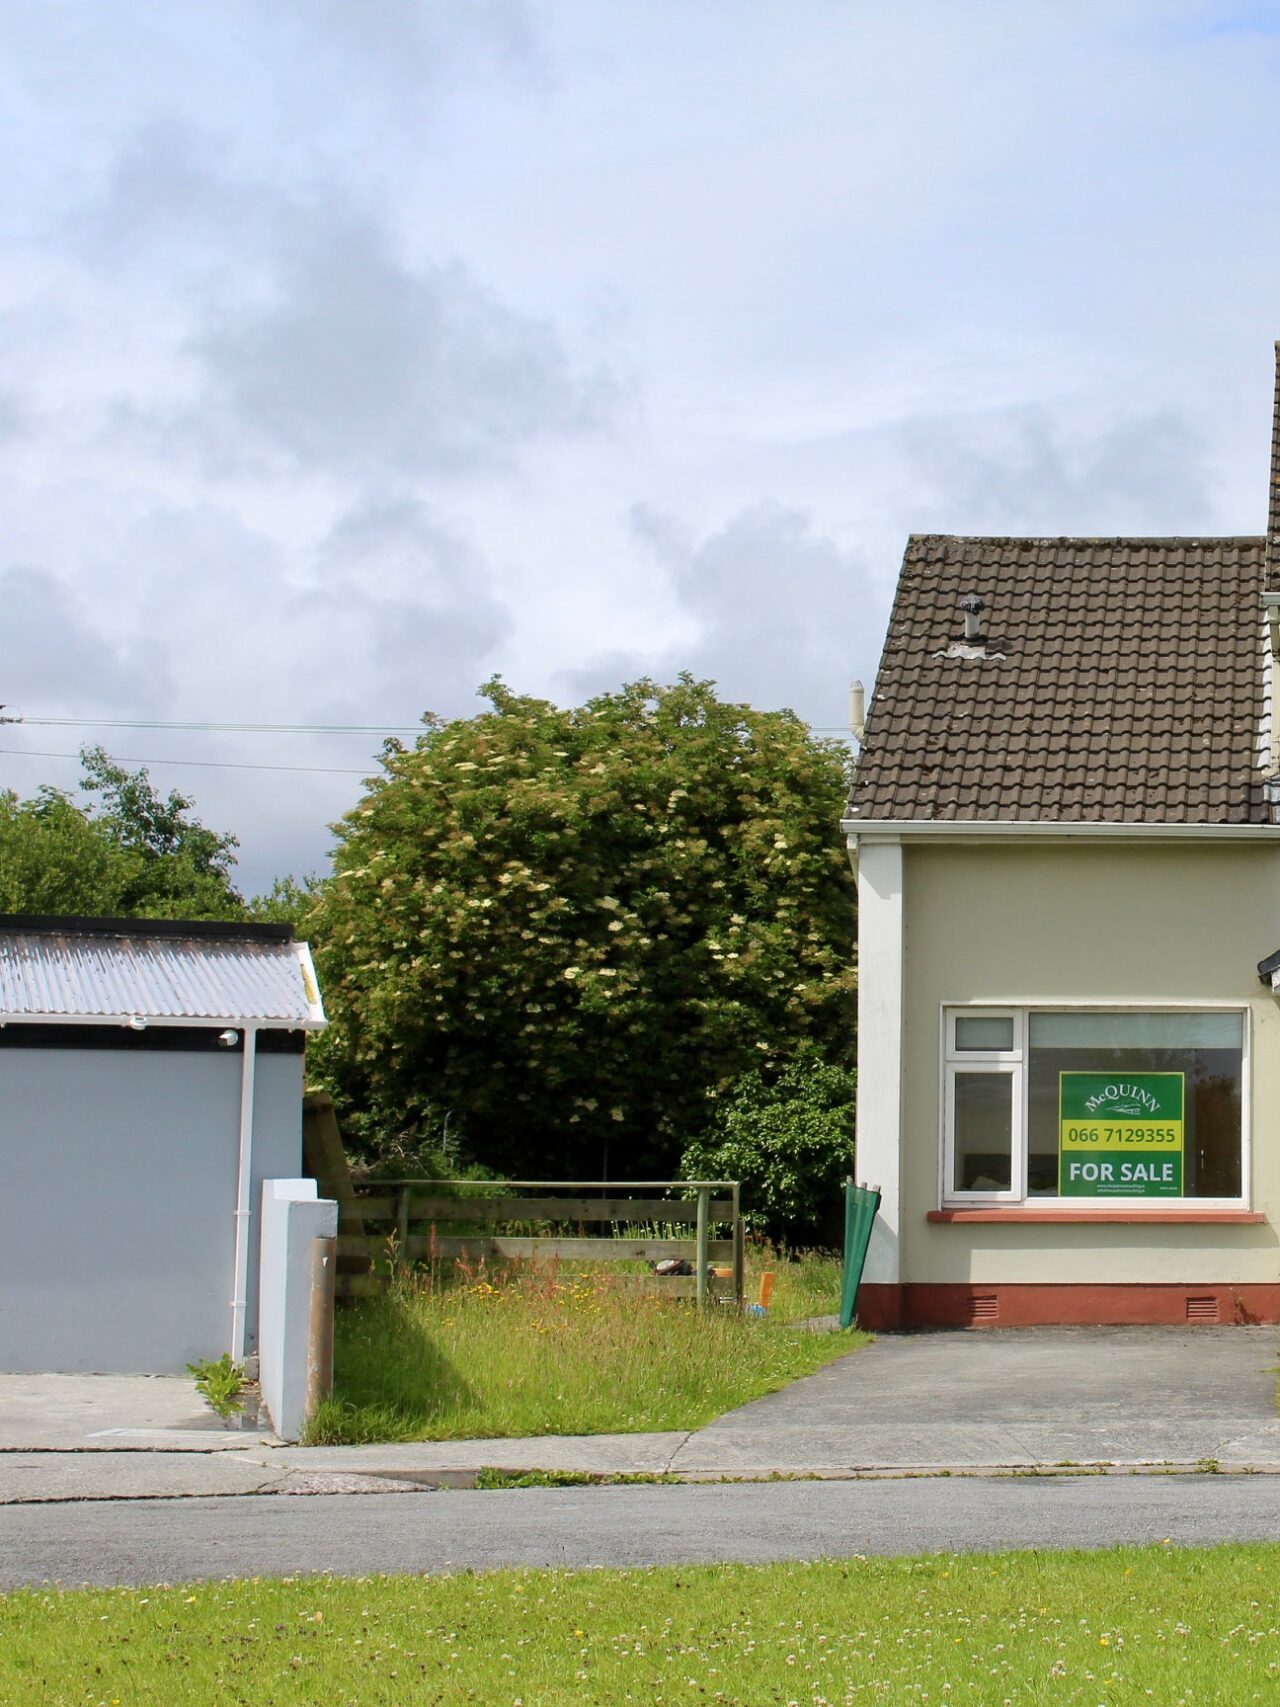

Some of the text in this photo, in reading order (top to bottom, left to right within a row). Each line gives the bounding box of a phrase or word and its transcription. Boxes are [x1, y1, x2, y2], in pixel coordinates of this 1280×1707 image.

[1085, 1084, 1160, 1112] McQUINN
[1069, 1128, 1176, 1142] 066 7129355
[1070, 1162, 1173, 1181] FOR SALE
